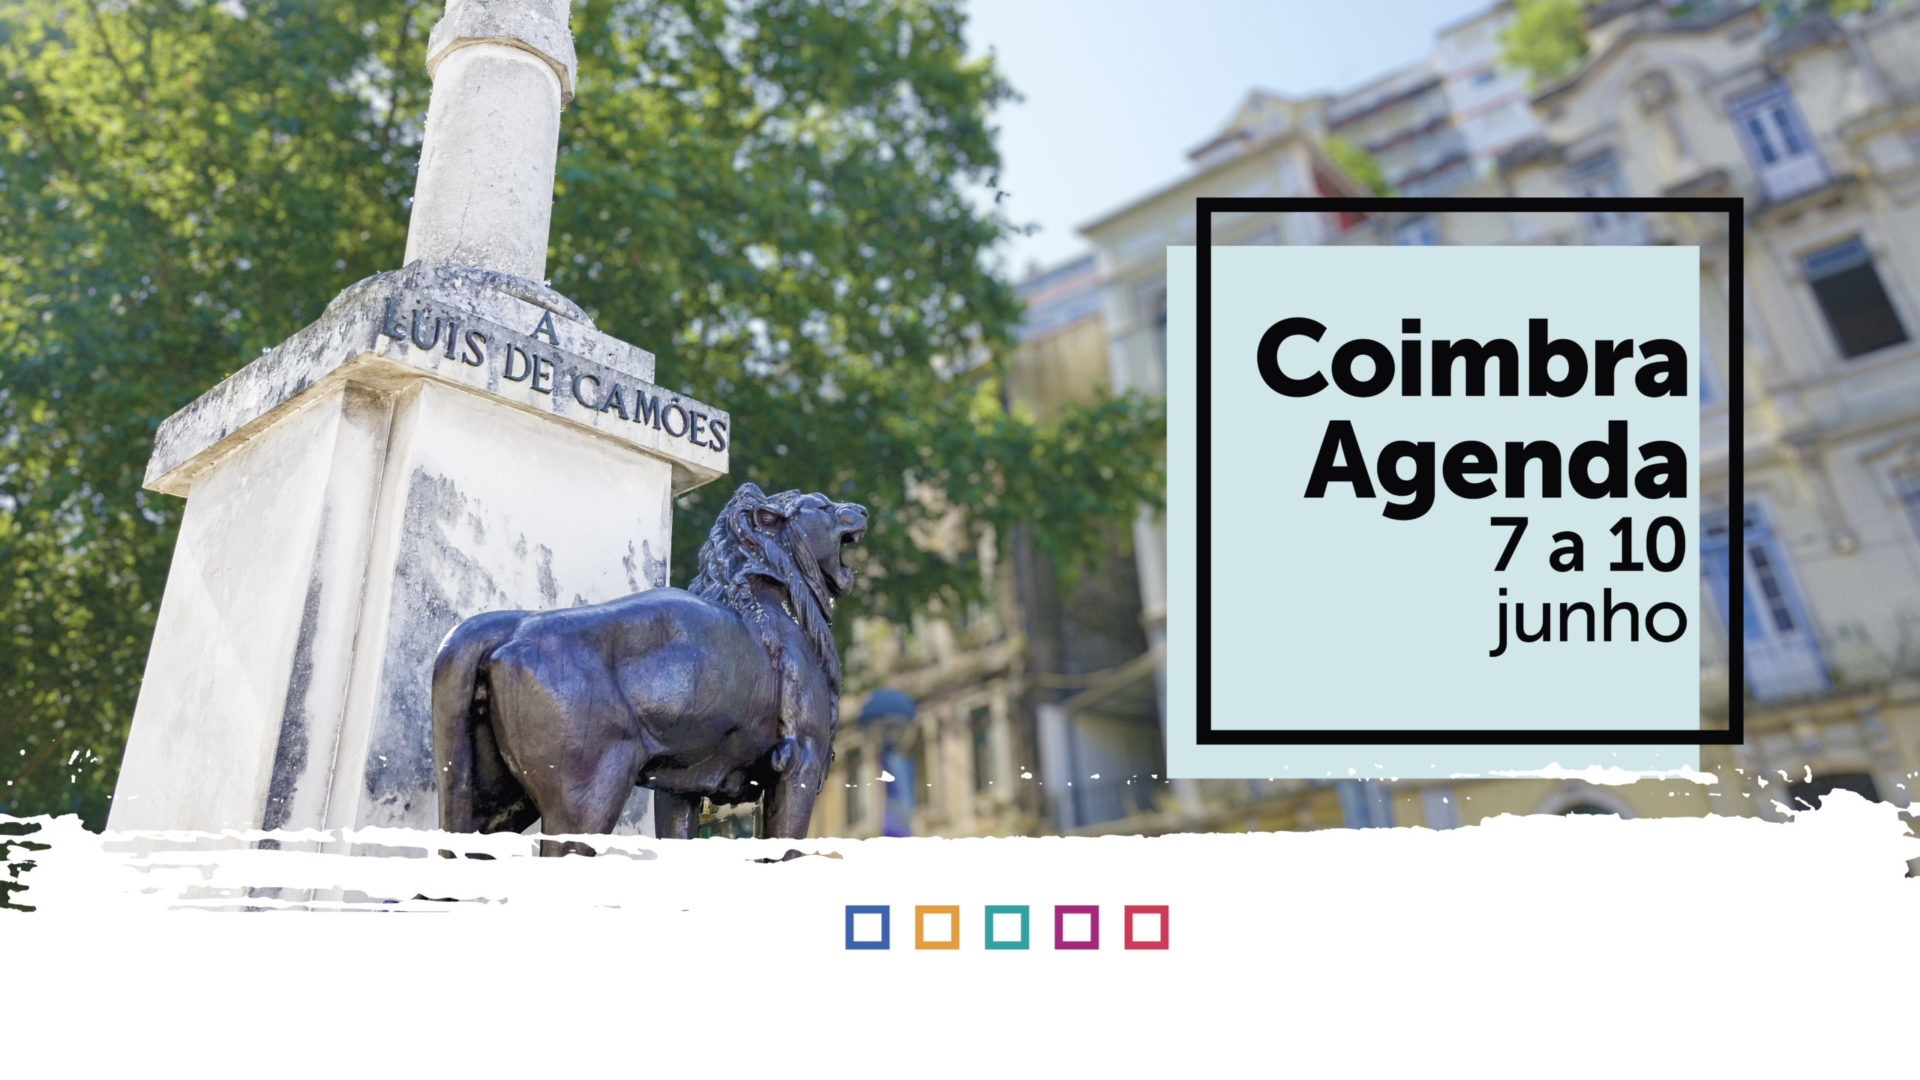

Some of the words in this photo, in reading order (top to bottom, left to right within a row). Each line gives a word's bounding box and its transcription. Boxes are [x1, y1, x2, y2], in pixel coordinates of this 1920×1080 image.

[383, 297, 487, 367] LUIS
[502, 342, 555, 395] DE
[572, 371, 727, 452] CAMÕES
[529, 309, 560, 346] A
